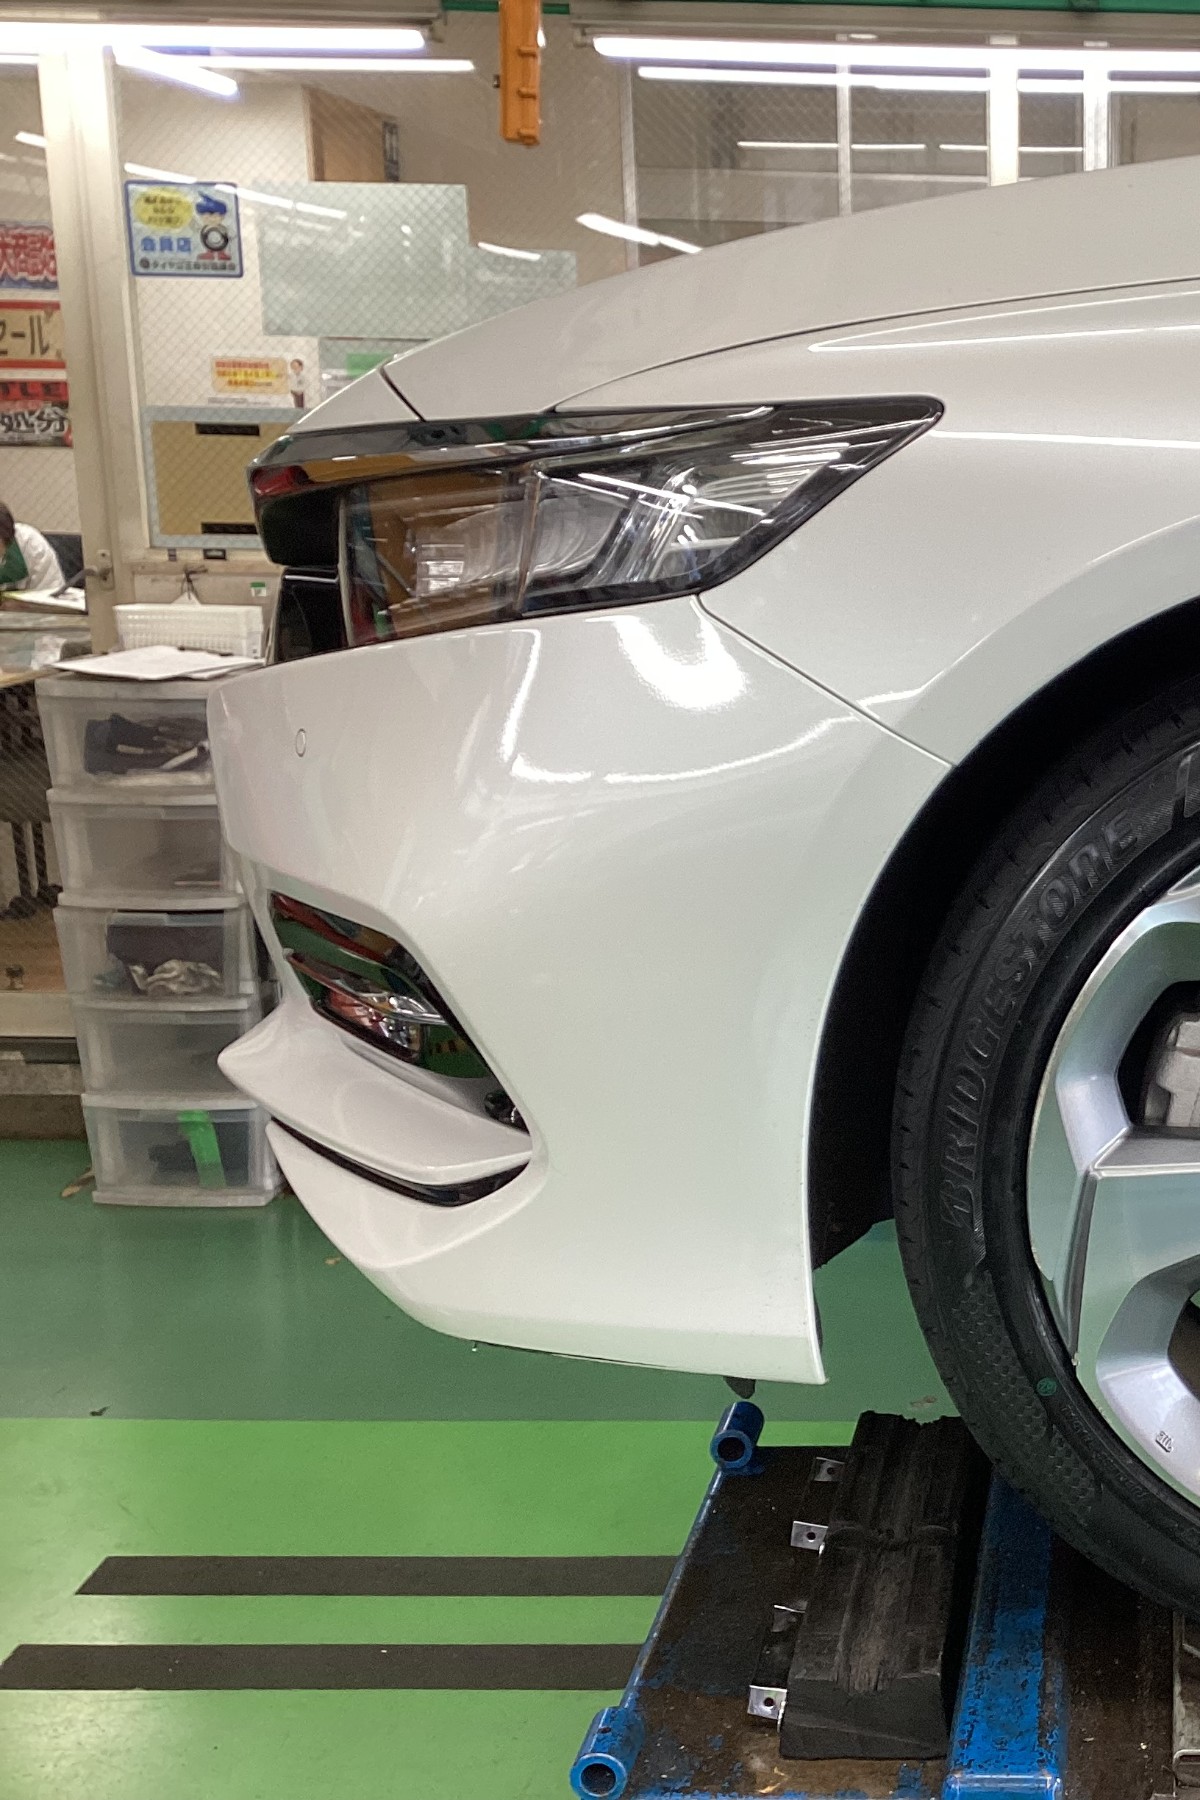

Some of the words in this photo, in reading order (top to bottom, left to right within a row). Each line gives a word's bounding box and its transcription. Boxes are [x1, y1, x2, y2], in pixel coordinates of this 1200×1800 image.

[141, 236, 192, 252] 会員店
[939, 805, 1140, 1230] BRIDGESTONE
